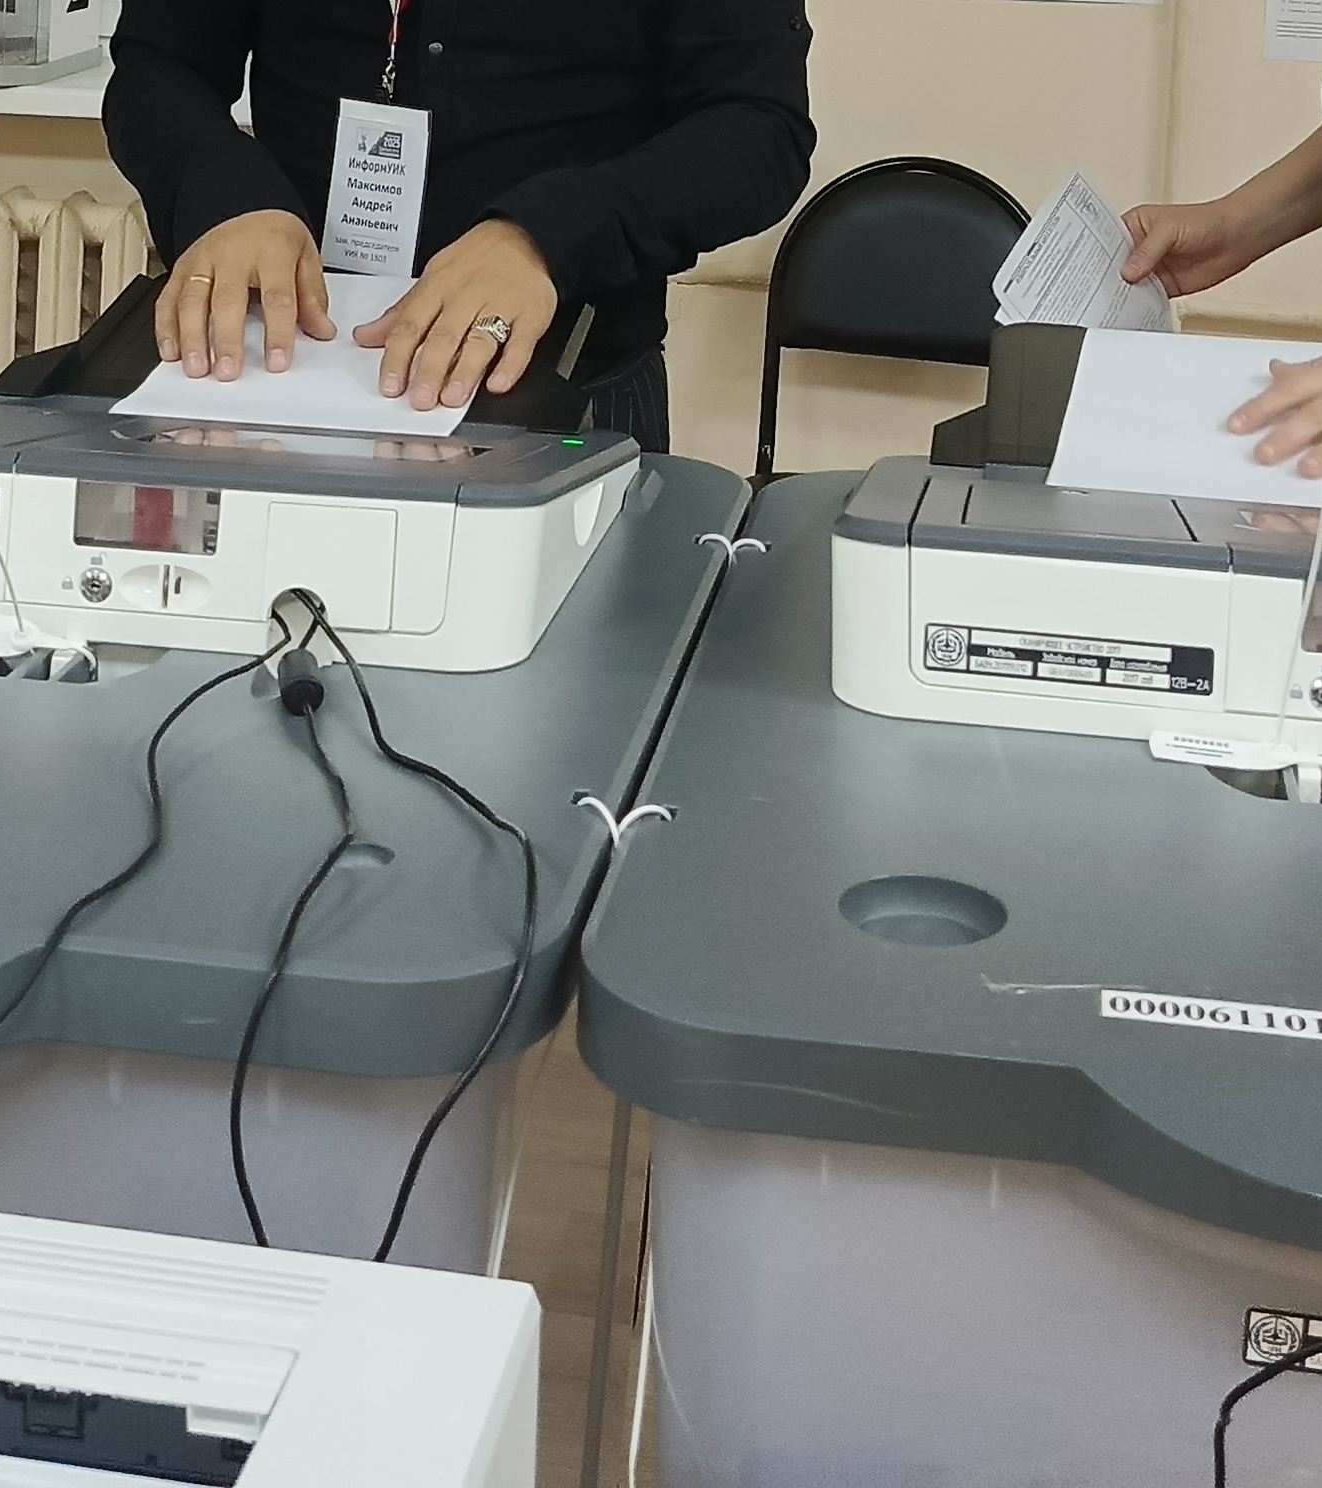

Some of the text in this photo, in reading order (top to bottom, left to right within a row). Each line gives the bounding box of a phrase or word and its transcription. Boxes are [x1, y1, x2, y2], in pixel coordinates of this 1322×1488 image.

[348, 156, 407, 176] ИнформУИК
[346, 177, 403, 196] Максимов
[351, 196, 393, 213] Андрей
[340, 213, 399, 232] Ананьевич
